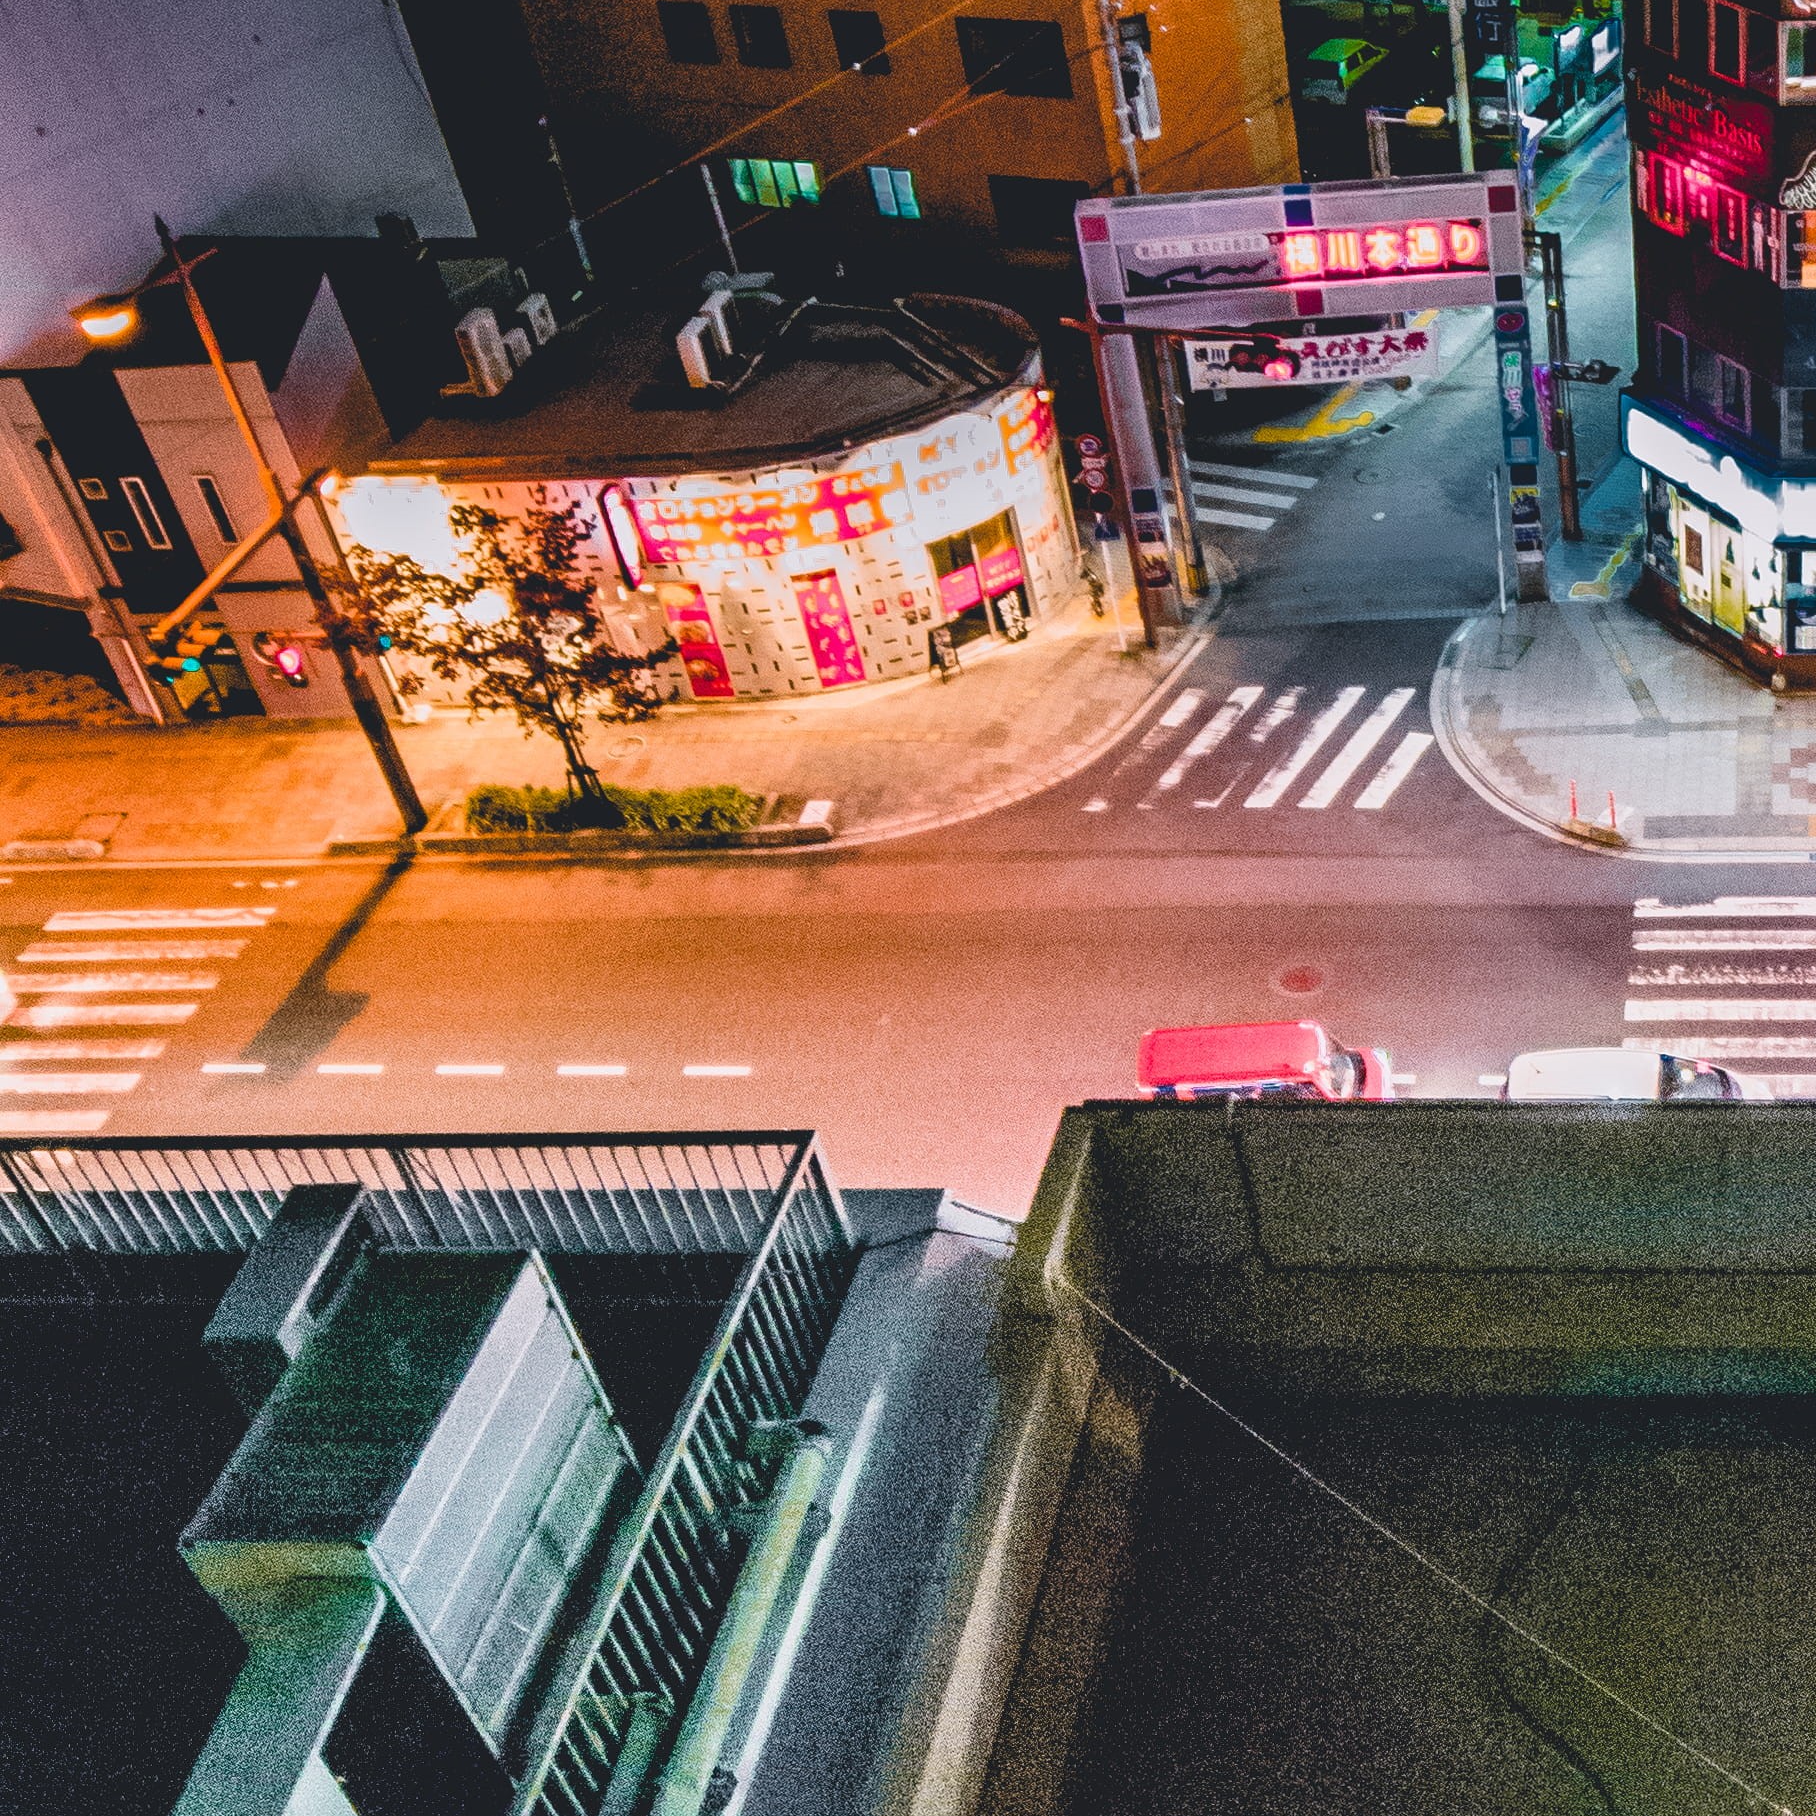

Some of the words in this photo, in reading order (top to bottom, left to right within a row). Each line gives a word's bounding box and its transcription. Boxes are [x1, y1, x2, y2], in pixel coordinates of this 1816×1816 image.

[1713, 109, 1764, 154] Basis
[1284, 223, 1481, 276] 横川本通り
